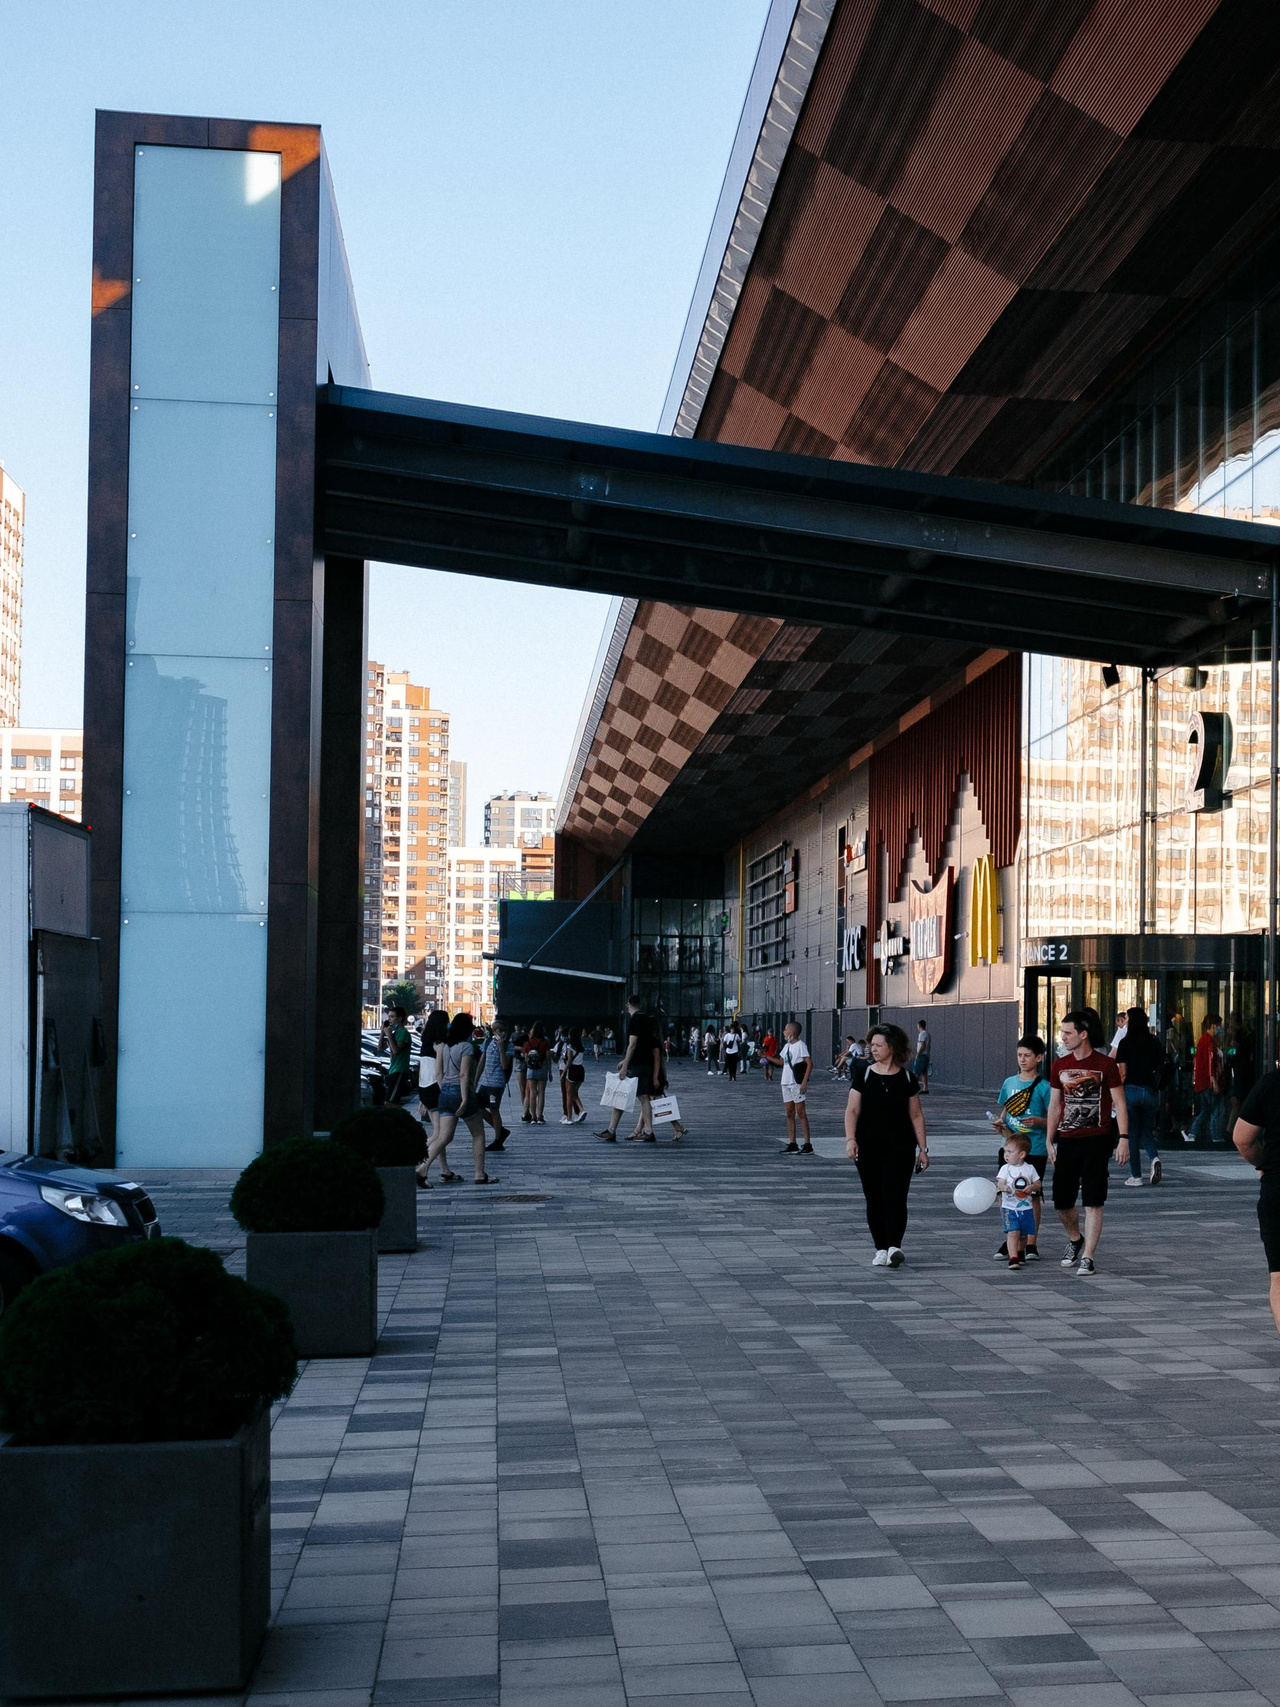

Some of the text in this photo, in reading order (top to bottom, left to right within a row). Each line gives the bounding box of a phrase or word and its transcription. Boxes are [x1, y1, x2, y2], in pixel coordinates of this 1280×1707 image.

[1185, 711, 1233, 813] 2
[842, 925, 865, 971] KFC
[1059, 943, 1069, 961] 2
